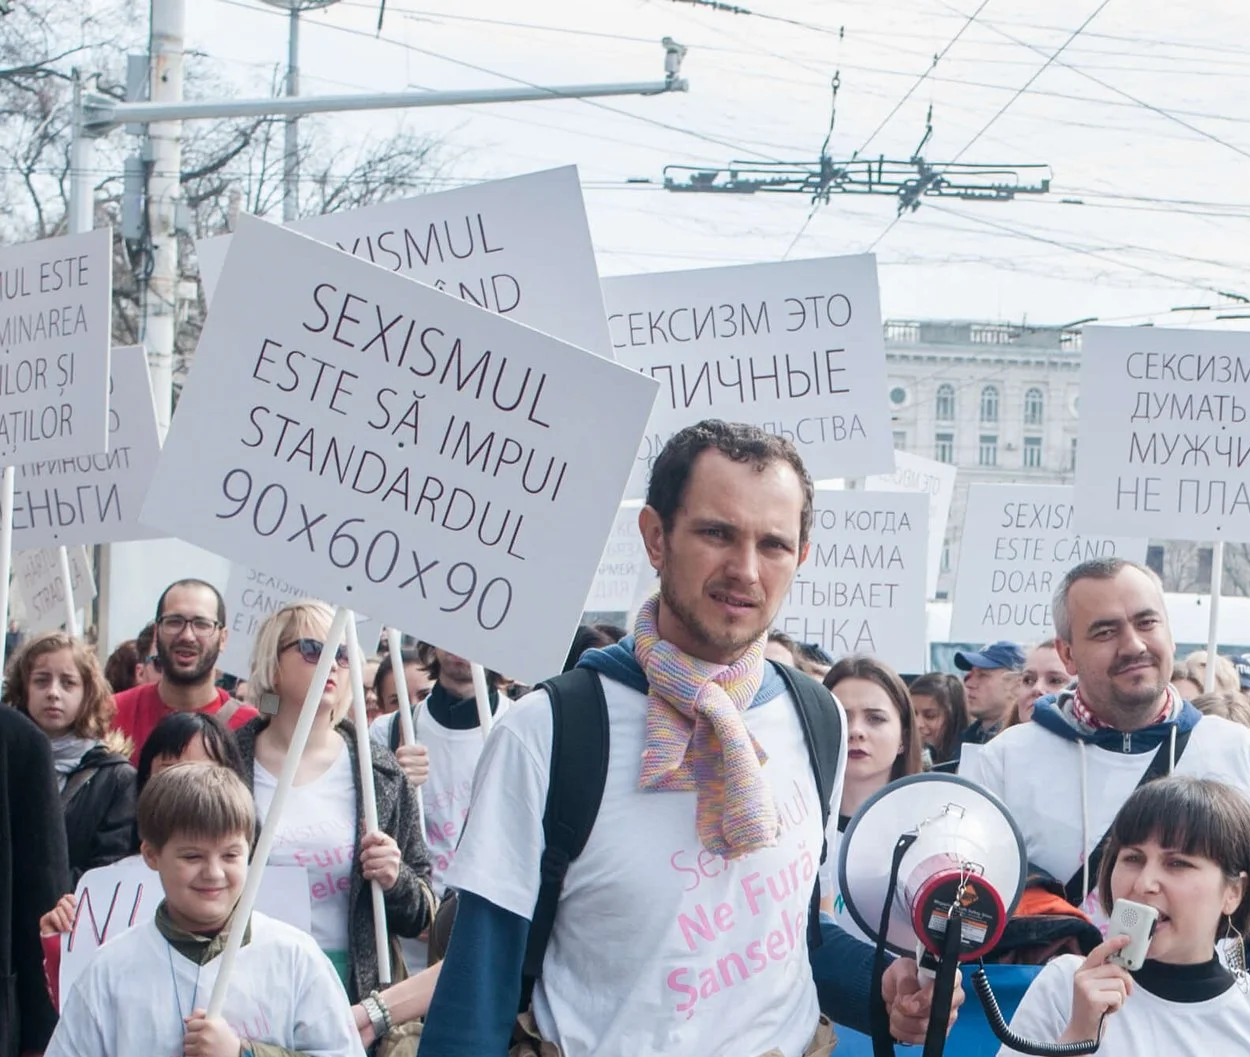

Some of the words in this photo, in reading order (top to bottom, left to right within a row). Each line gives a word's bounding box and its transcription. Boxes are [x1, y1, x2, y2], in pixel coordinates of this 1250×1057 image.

[40, 255, 89, 293] ESTE
[785, 293, 852, 332] ЭТО
[57, 352, 75, 398] ȘI
[302, 283, 550, 428] SEXISMUL
[640, 349, 850, 409] ЛИЧНЫЕ
[252, 338, 359, 415] ESTE
[368, 388, 426, 445] SĂ
[440, 415, 568, 501] IMPUI
[1130, 392, 1247, 423] ДУМАТЬ
[0, 403, 73, 452] AȚILOR
[241, 405, 527, 560] STANDARDUL
[1116, 476, 1161, 513] НЕ
[2, 483, 122, 531] ЕНЬГИ
[813, 509, 836, 530] ТО
[845, 510, 912, 535] КОГДА
[814, 543, 905, 570] МАМА
[994, 536, 1045, 561] ESTE
[991, 569, 1053, 593] DOAR
[784, 616, 877, 653] ЕНКА
[677, 904, 735, 952] Ne
[741, 841, 815, 917] Fură
